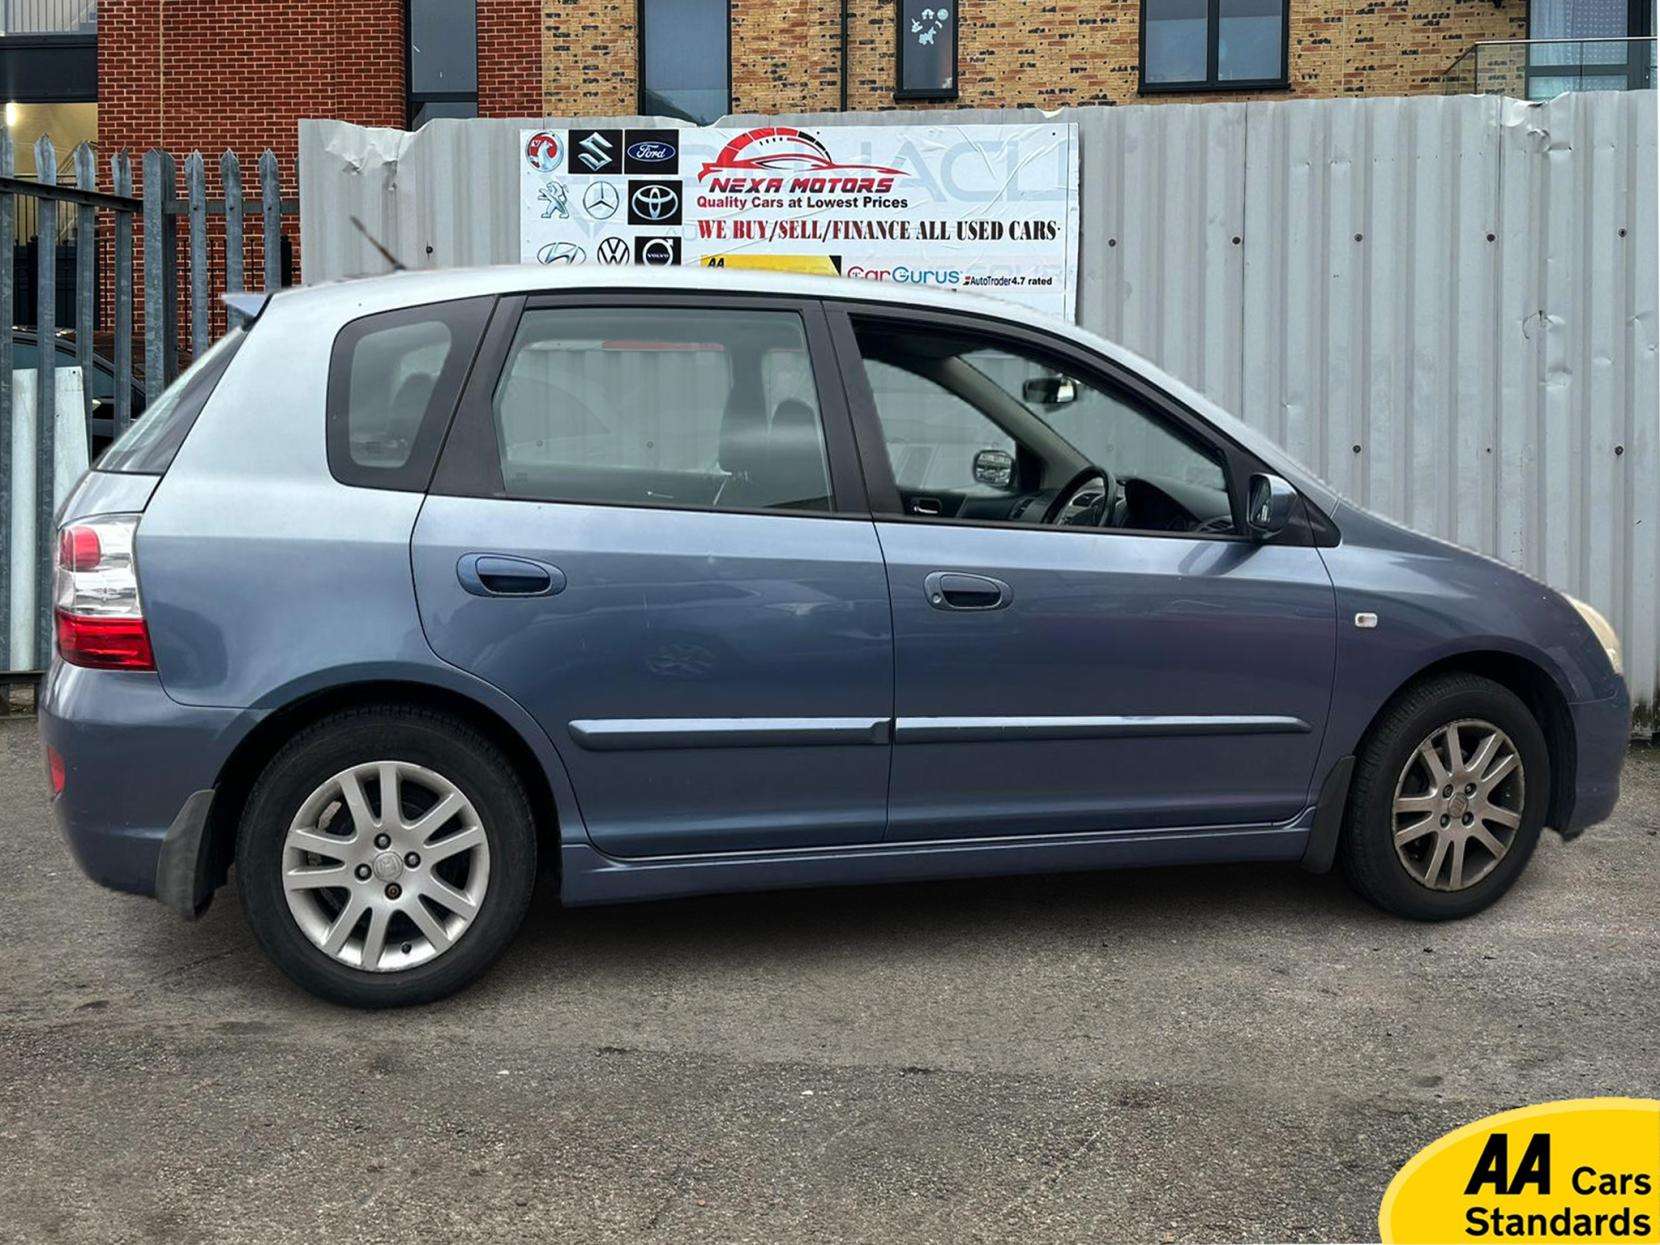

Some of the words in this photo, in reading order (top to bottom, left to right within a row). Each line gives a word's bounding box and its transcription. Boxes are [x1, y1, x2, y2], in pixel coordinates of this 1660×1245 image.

[636, 144, 665, 159] Ford
[708, 178, 784, 194] NEXA
[789, 177, 895, 194] MOTORS
[697, 195, 747, 210] Quality
[751, 195, 784, 208] Cars
[788, 196, 803, 208] at
[807, 195, 859, 208] Lowest
[863, 195, 908, 208] Prices
[697, 219, 727, 240] WE
[916, 219, 950, 240] ALL
[957, 219, 1004, 240] USED
[1009, 219, 1057, 240] CARS
[707, 257, 725, 268] AA
[847, 266, 960, 284] CarGurus
[1028, 276, 1053, 286] rated
